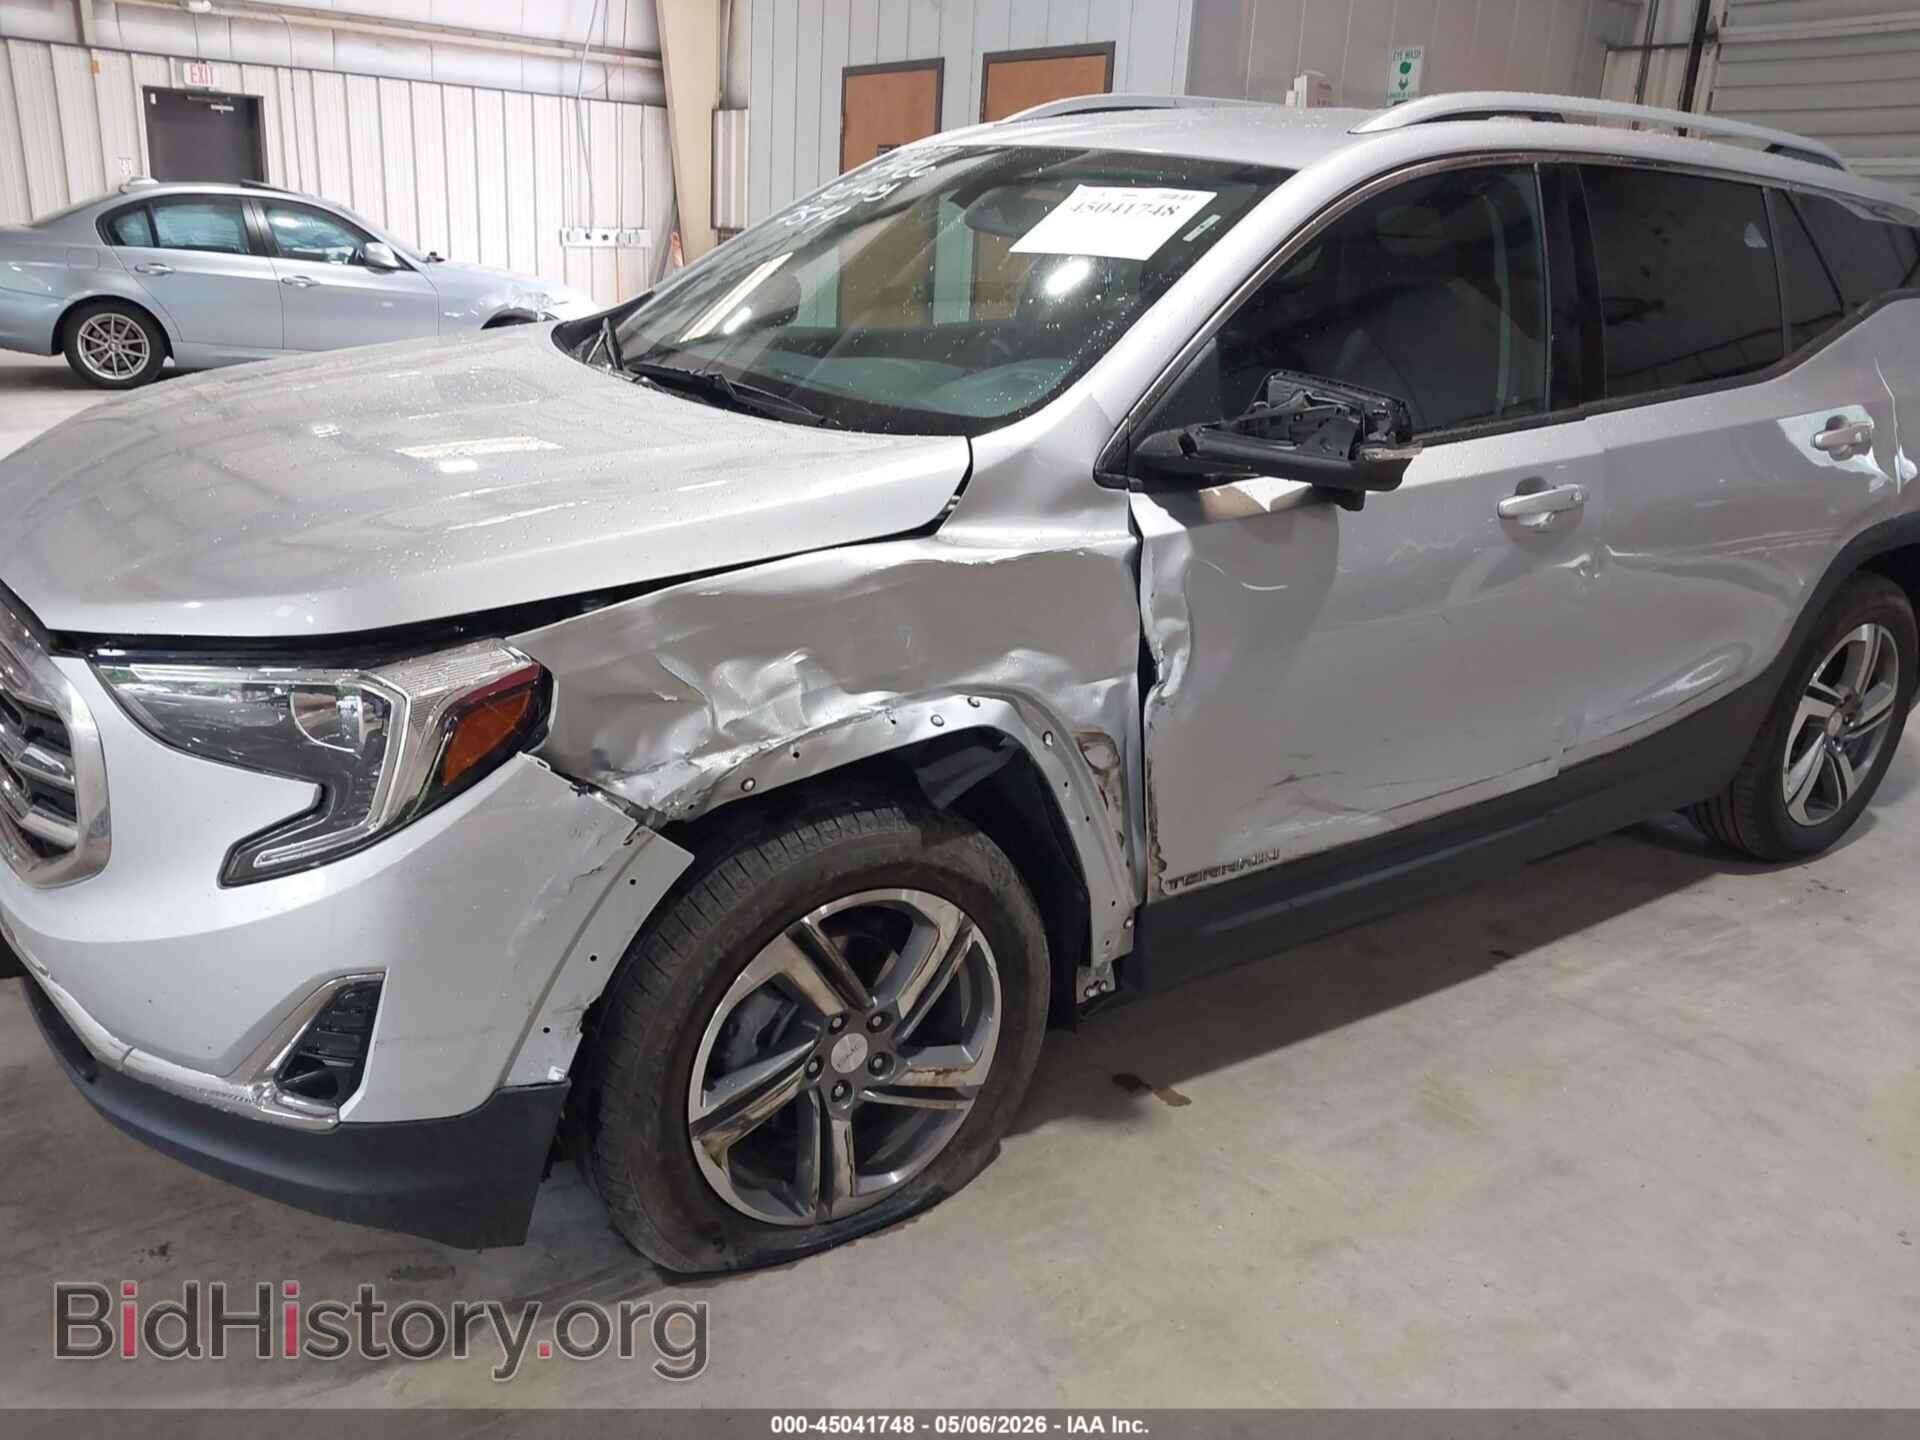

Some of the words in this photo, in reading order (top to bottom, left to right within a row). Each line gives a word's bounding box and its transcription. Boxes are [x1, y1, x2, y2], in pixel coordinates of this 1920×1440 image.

[191, 63, 214, 85] EXIT
[1070, 201, 1181, 217] 45041748
[1165, 847, 1280, 890] TERRAIN
